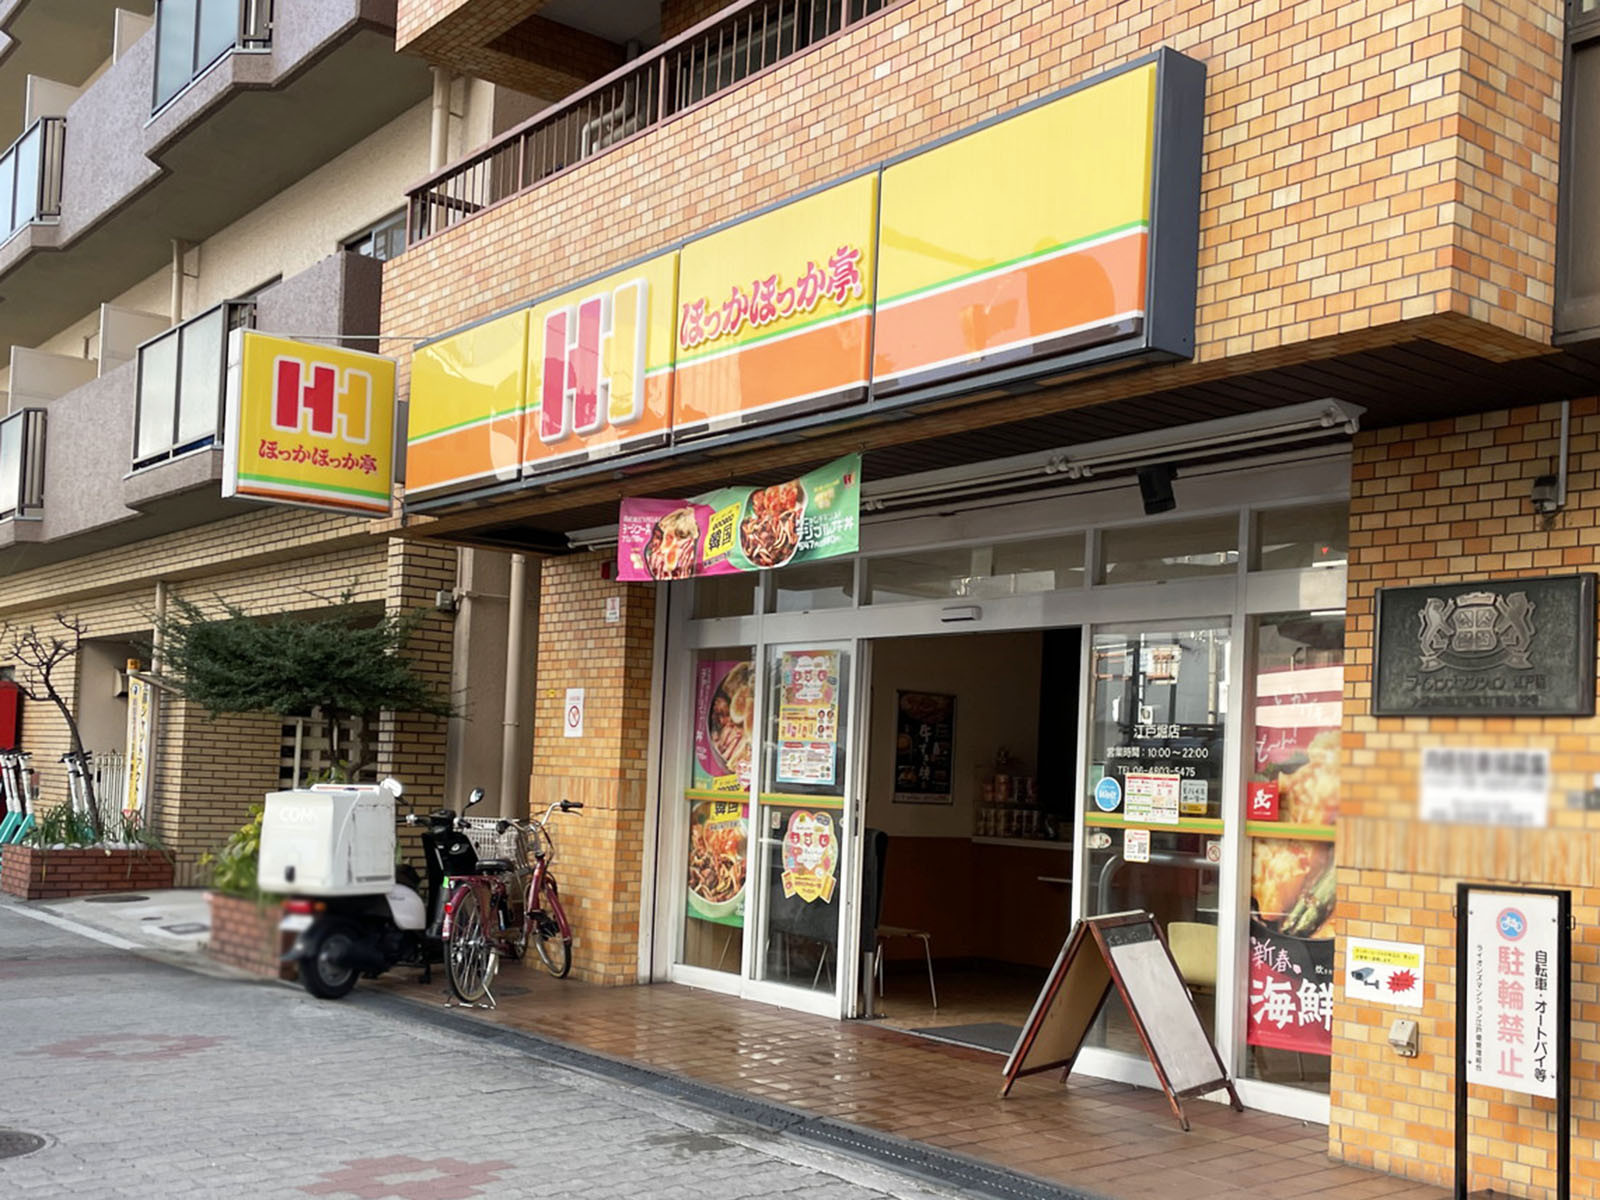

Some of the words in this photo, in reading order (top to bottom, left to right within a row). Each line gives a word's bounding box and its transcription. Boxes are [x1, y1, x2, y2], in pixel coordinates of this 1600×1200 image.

[679, 244, 862, 350] ほっかほっか亭
[257, 439, 378, 475] ほっかほっか亭
[709, 522, 733, 551] 韓国
[1133, 724, 1181, 739] 江戸堀店
[1252, 938, 1292, 972] 新春
[1250, 975, 1334, 1031] 海鮮
[1496, 945, 1526, 1080] 駐輪禁止
[1533, 949, 1548, 1083] 自転車・オートバイ等
